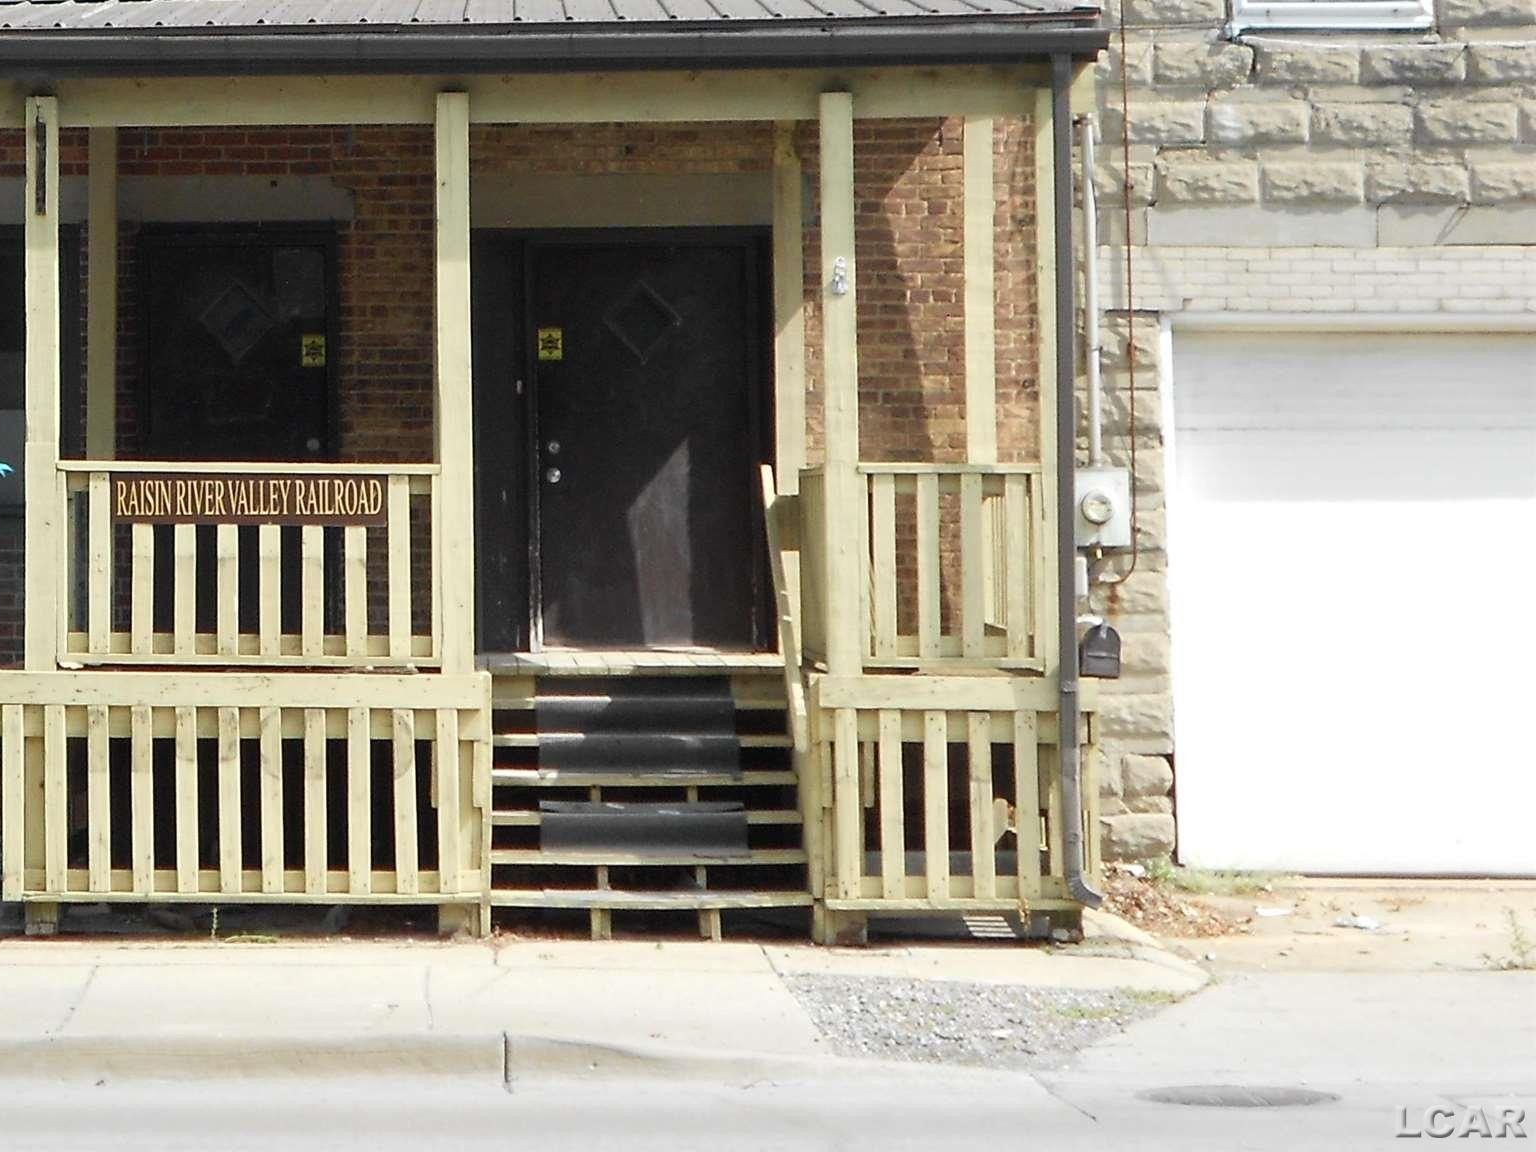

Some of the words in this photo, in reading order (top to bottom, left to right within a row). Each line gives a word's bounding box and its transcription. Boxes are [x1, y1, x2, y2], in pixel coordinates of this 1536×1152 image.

[116, 480, 172, 516] RAISIN
[175, 480, 227, 516] RIVER
[227, 480, 291, 516] VALLEY
[295, 479, 383, 516] RAILROAD
